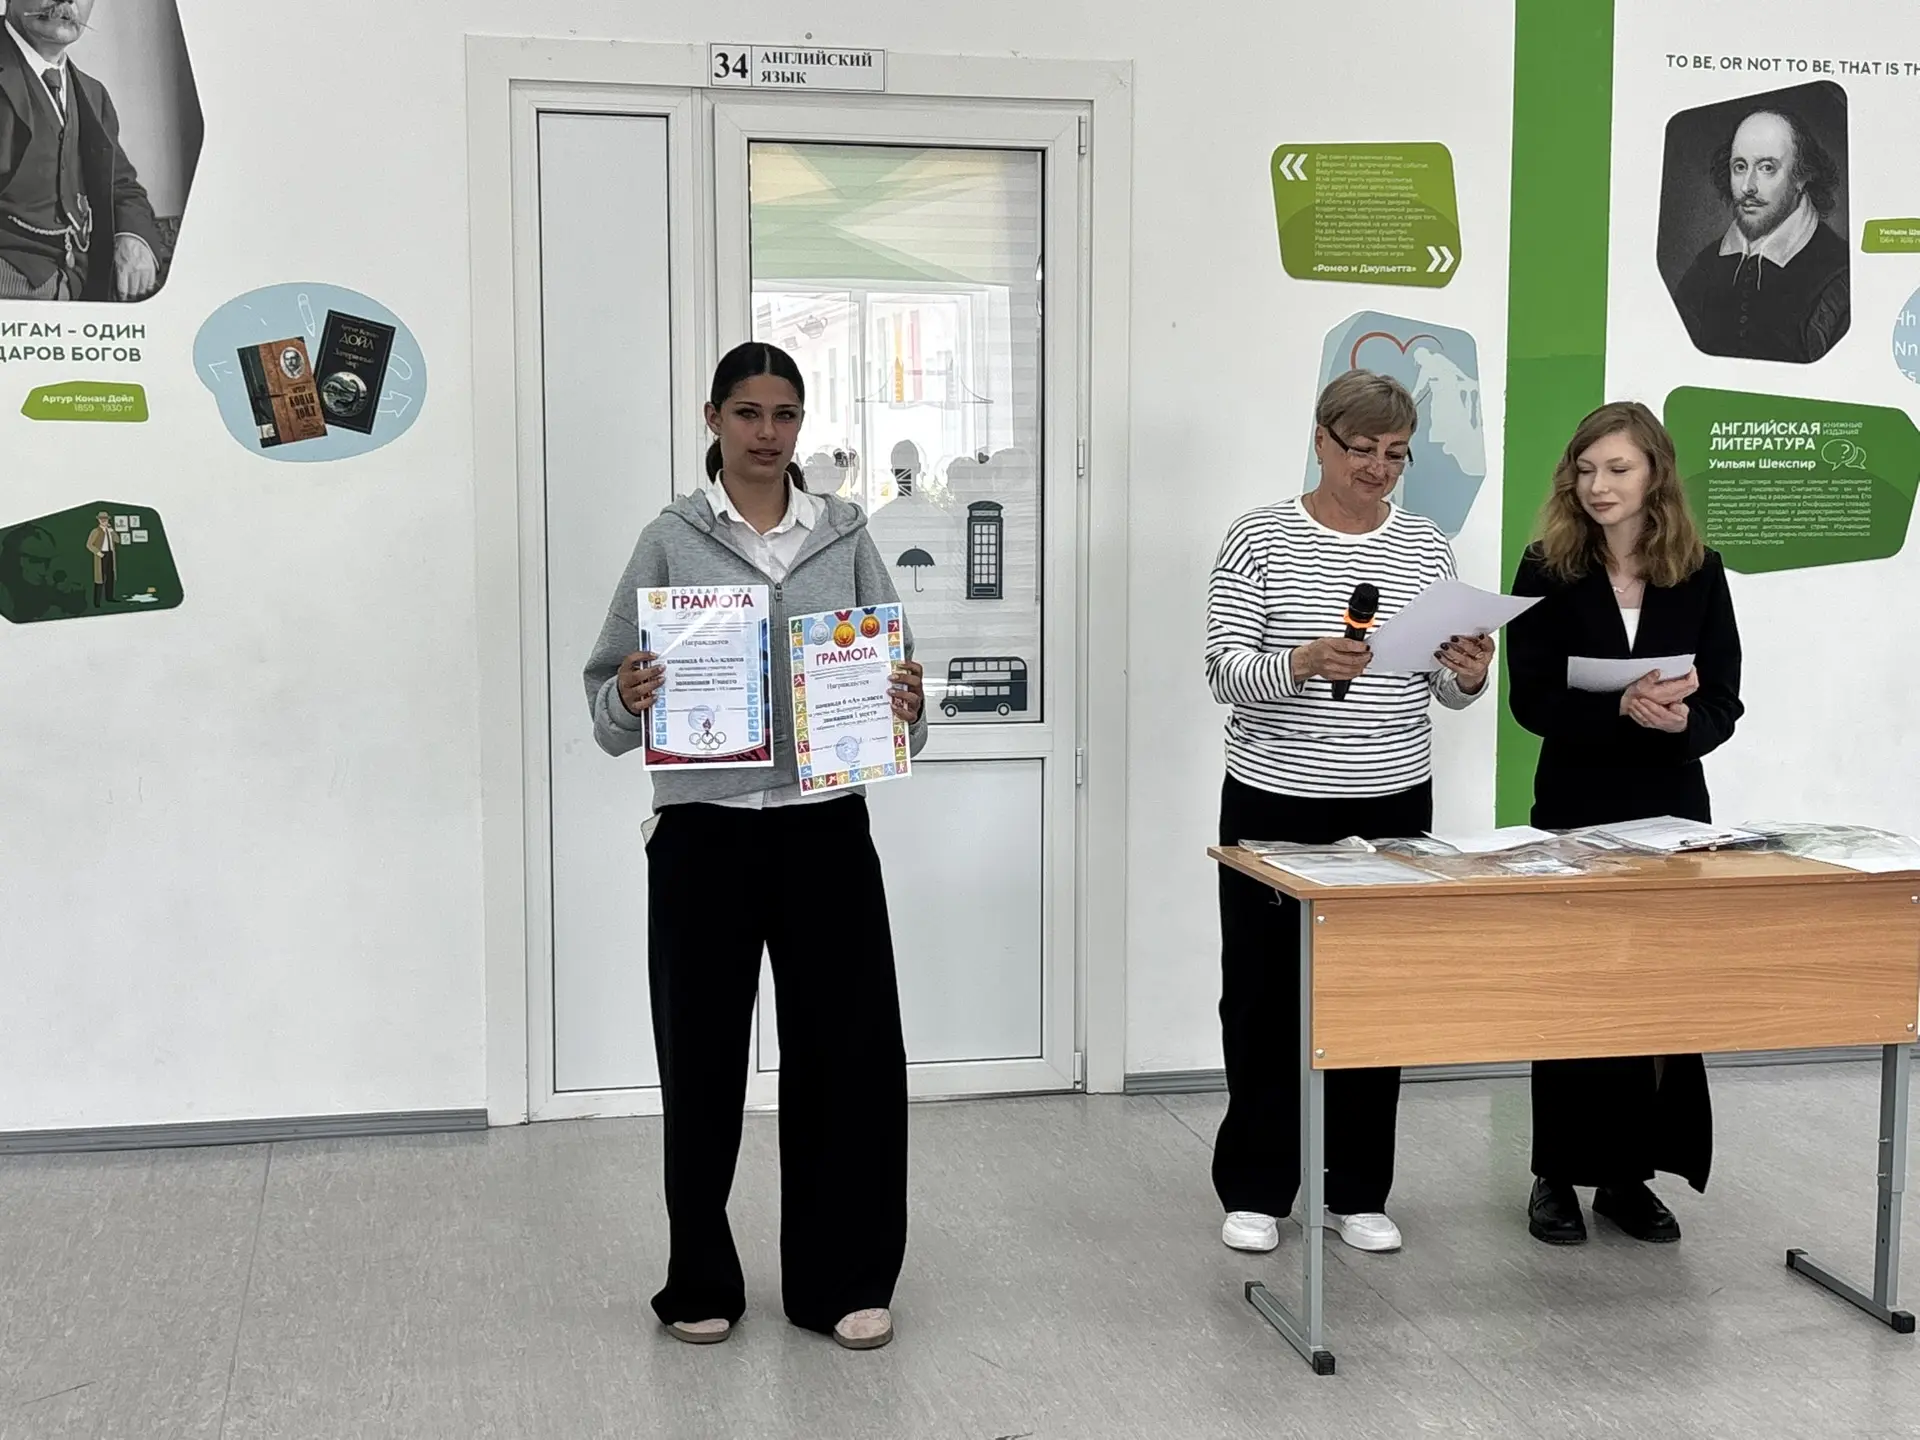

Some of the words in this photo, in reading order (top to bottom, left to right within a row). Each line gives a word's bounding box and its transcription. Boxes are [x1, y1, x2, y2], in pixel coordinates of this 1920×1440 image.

[714, 52, 749, 79] 34
[760, 50, 872, 67] АНГЛИЙСКИЙ
[1666, 54, 1688, 68] TO
[1692, 55, 1716, 71] BE,
[1720, 56, 1743, 70] OR
[1747, 57, 1782, 71] NOT
[1787, 59, 1808, 72] TO
[1812, 60, 1835, 75] BE,
[1839, 61, 1882, 75] THAT
[1886, 62, 1900, 75] IS
[761, 70, 807, 84] ЯЗЫК
[1312, 264, 1350, 273] «Ромео
[1359, 264, 1417, 275] Джульетта»
[1, 322, 61, 338] ИГАМ
[83, 323, 146, 342] ОДИН
[71, 346, 142, 362] БОГОВ
[1895, 340, 1918, 356] Nn
[42, 394, 73, 405] Артур
[75, 394, 106, 403] Конан
[107, 394, 134, 404] Дойл
[1709, 419, 1821, 436] АНГЛИЙСКАЯ
[1709, 437, 1816, 451] ЛИТЕРАТУРА
[1708, 458, 1755, 469] Уильям
[1758, 458, 1817, 471] Шекспир
[671, 593, 754, 610] ГРАМОТА
[816, 646, 878, 666] ГРАМОТА
